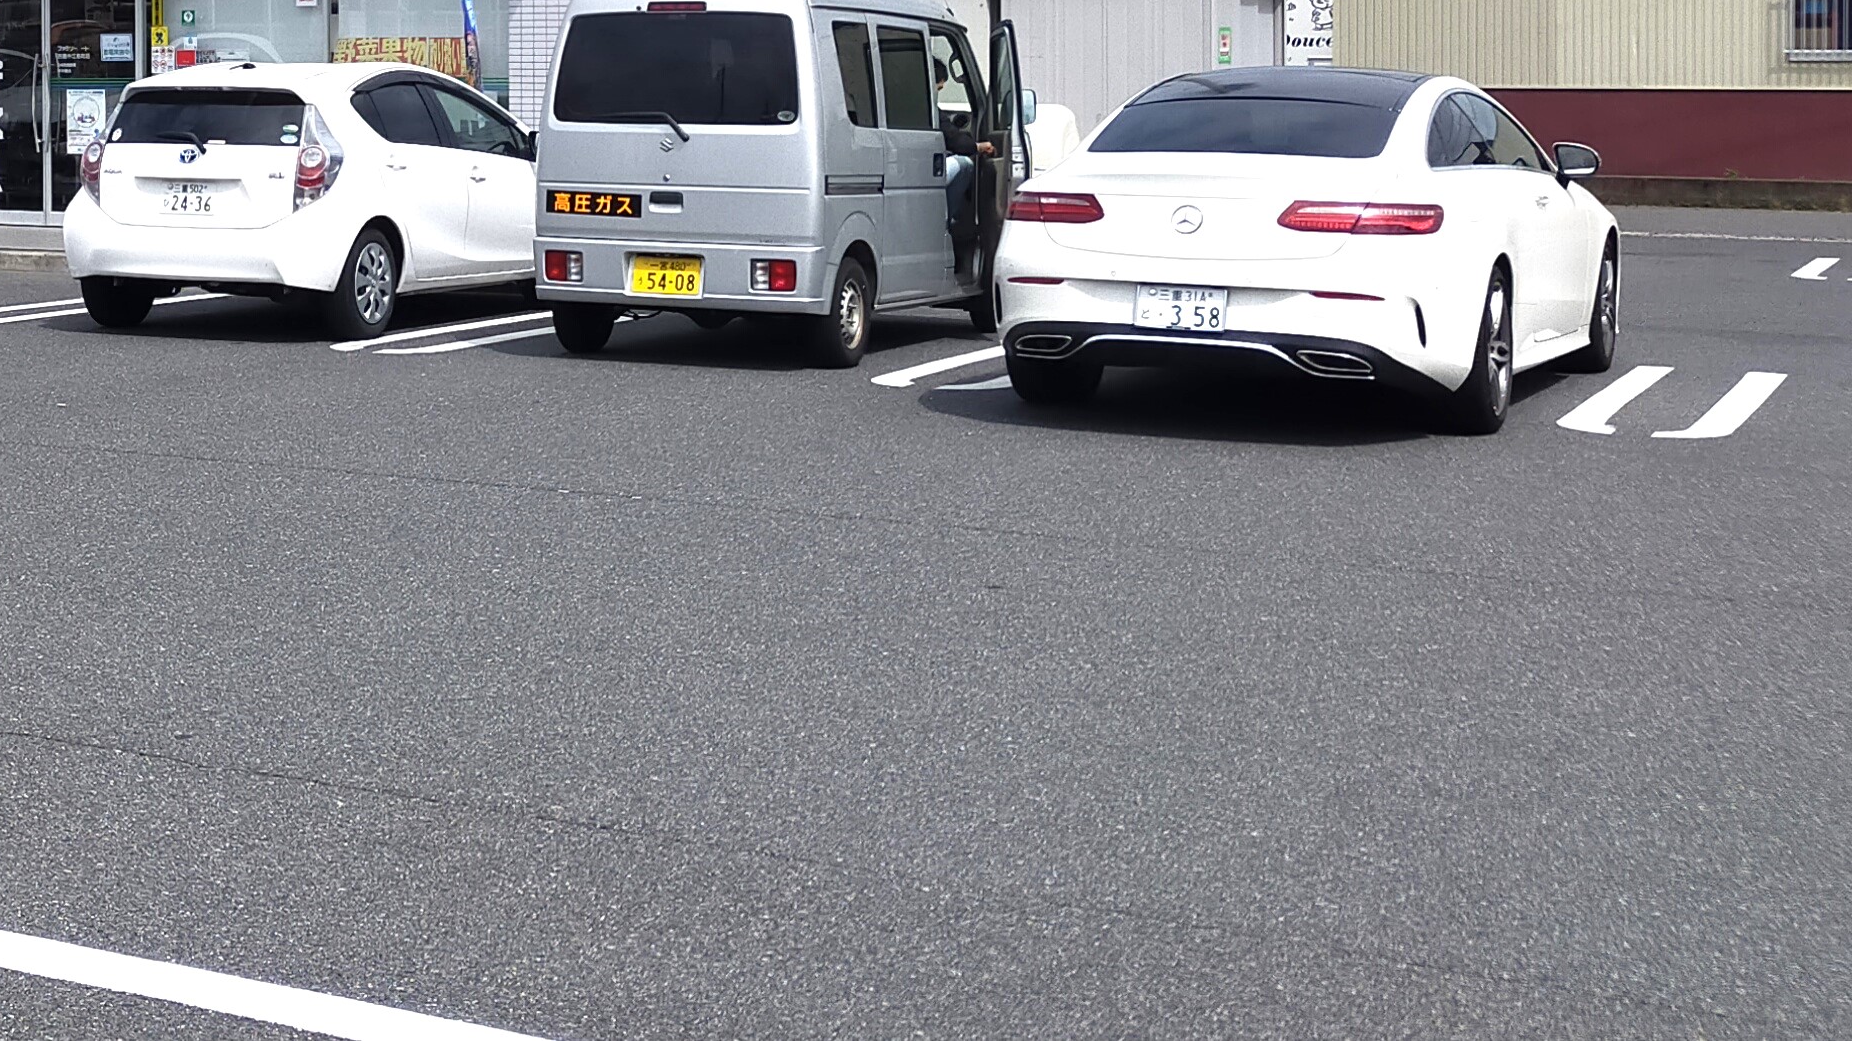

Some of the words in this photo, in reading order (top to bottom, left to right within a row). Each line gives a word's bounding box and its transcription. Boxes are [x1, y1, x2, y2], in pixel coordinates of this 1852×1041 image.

[333, 37, 427, 67] 野菜果物
[171, 195, 211, 212] 24-36
[554, 192, 633, 215] 高圧ガス
[647, 273, 695, 291] 54-08
